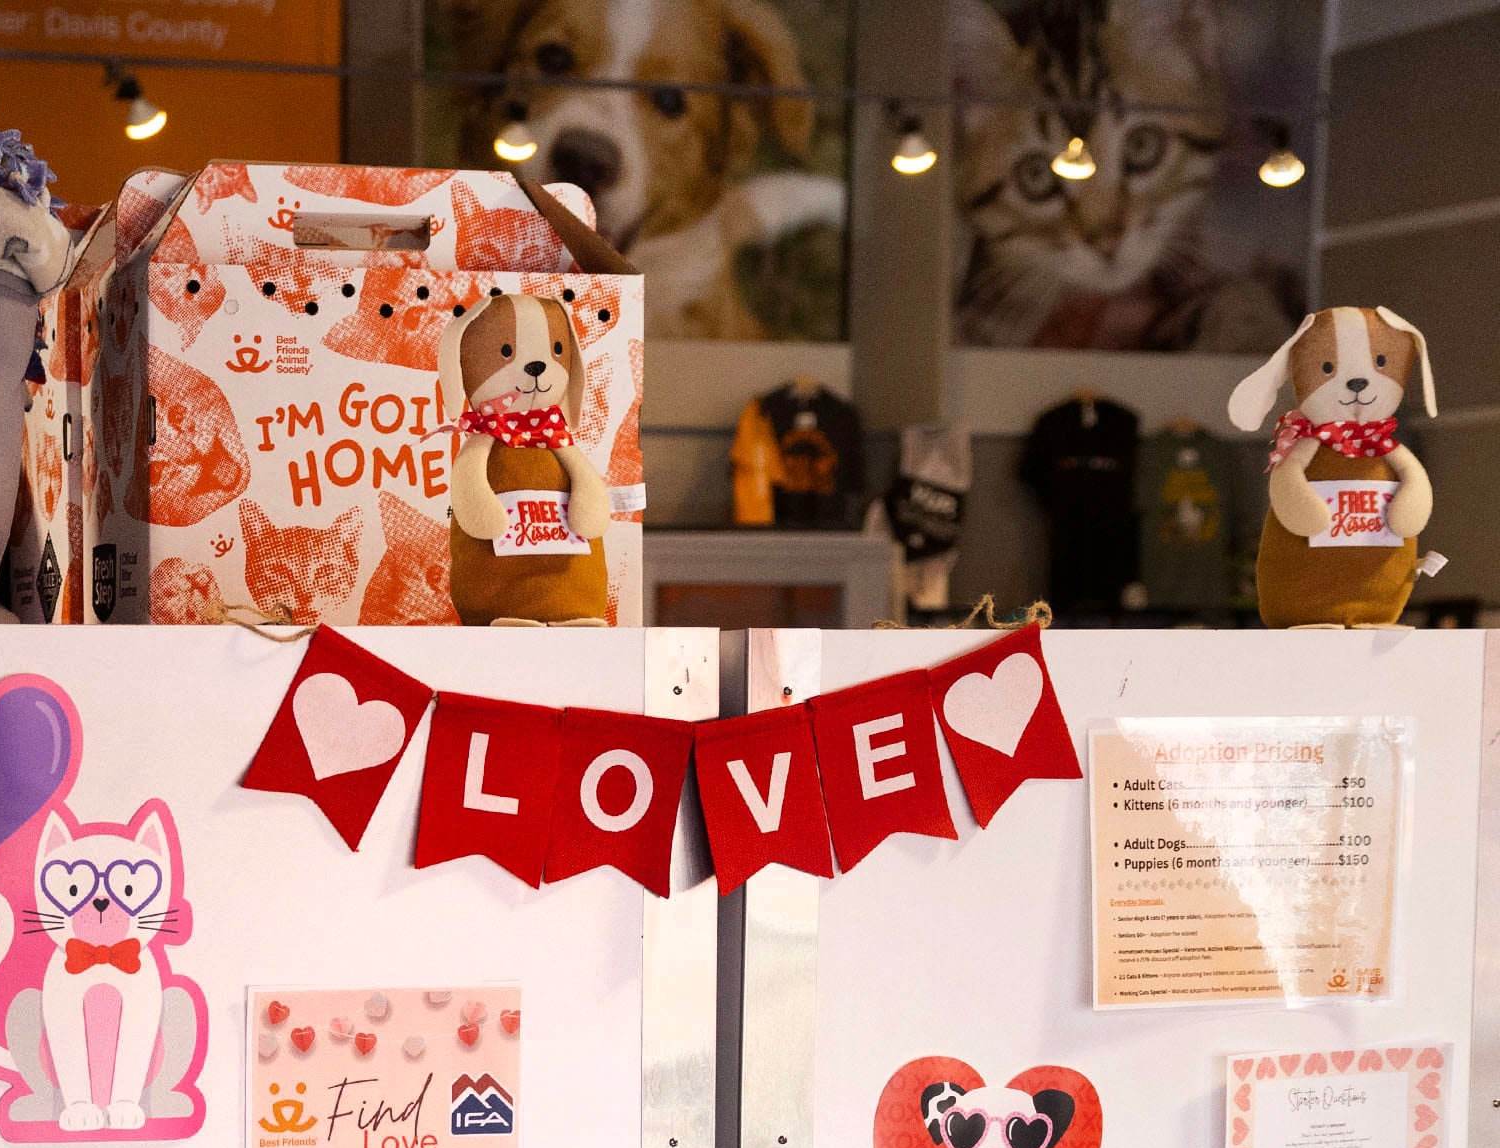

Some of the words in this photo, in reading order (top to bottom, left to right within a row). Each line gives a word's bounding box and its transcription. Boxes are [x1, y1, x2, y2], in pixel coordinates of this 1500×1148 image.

[128, 12, 228, 49] County
[276, 335, 297, 345] Best
[276, 345, 310, 355] Friends
[276, 354, 309, 365] Animal
[276, 364, 312, 376] Society
[255, 401, 325, 452] I'M
[517, 501, 562, 524] FREE
[1338, 491, 1379, 513] FREE
[514, 522, 570, 547] Kisses
[1330, 512, 1386, 538] Kisses
[1155, 743, 1248, 763] Adoption
[1255, 741, 1325, 765] Pricing
[463, 712, 916, 834] LOVE
[1123, 779, 1156, 791] Adult
[1341, 776, 1367, 789] $50
[1123, 799, 1165, 811] Kittens
[1167, 799, 1180, 811] (6
[1182, 799, 1228, 810] months
[1229, 799, 1251, 809] and
[1253, 798, 1309, 812] younger)
[1341, 796, 1375, 809] $100
[1123, 838, 1155, 850] Adult
[1157, 838, 1187, 852] Dogs
[1339, 834, 1372, 847] $100
[1123, 858, 1170, 873] Puppies
[1171, 858, 1185, 870] (6
[1257, 855, 1311, 870] younger)
[1339, 853, 1370, 866] $150
[326, 1071, 434, 1142] Find
[1288, 1086, 1321, 1112] Starter
[1322, 1084, 1368, 1111] Questions
[456, 1111, 510, 1128] IFA
[259, 1138, 280, 1148] Best
[282, 1138, 317, 1148] Friends
